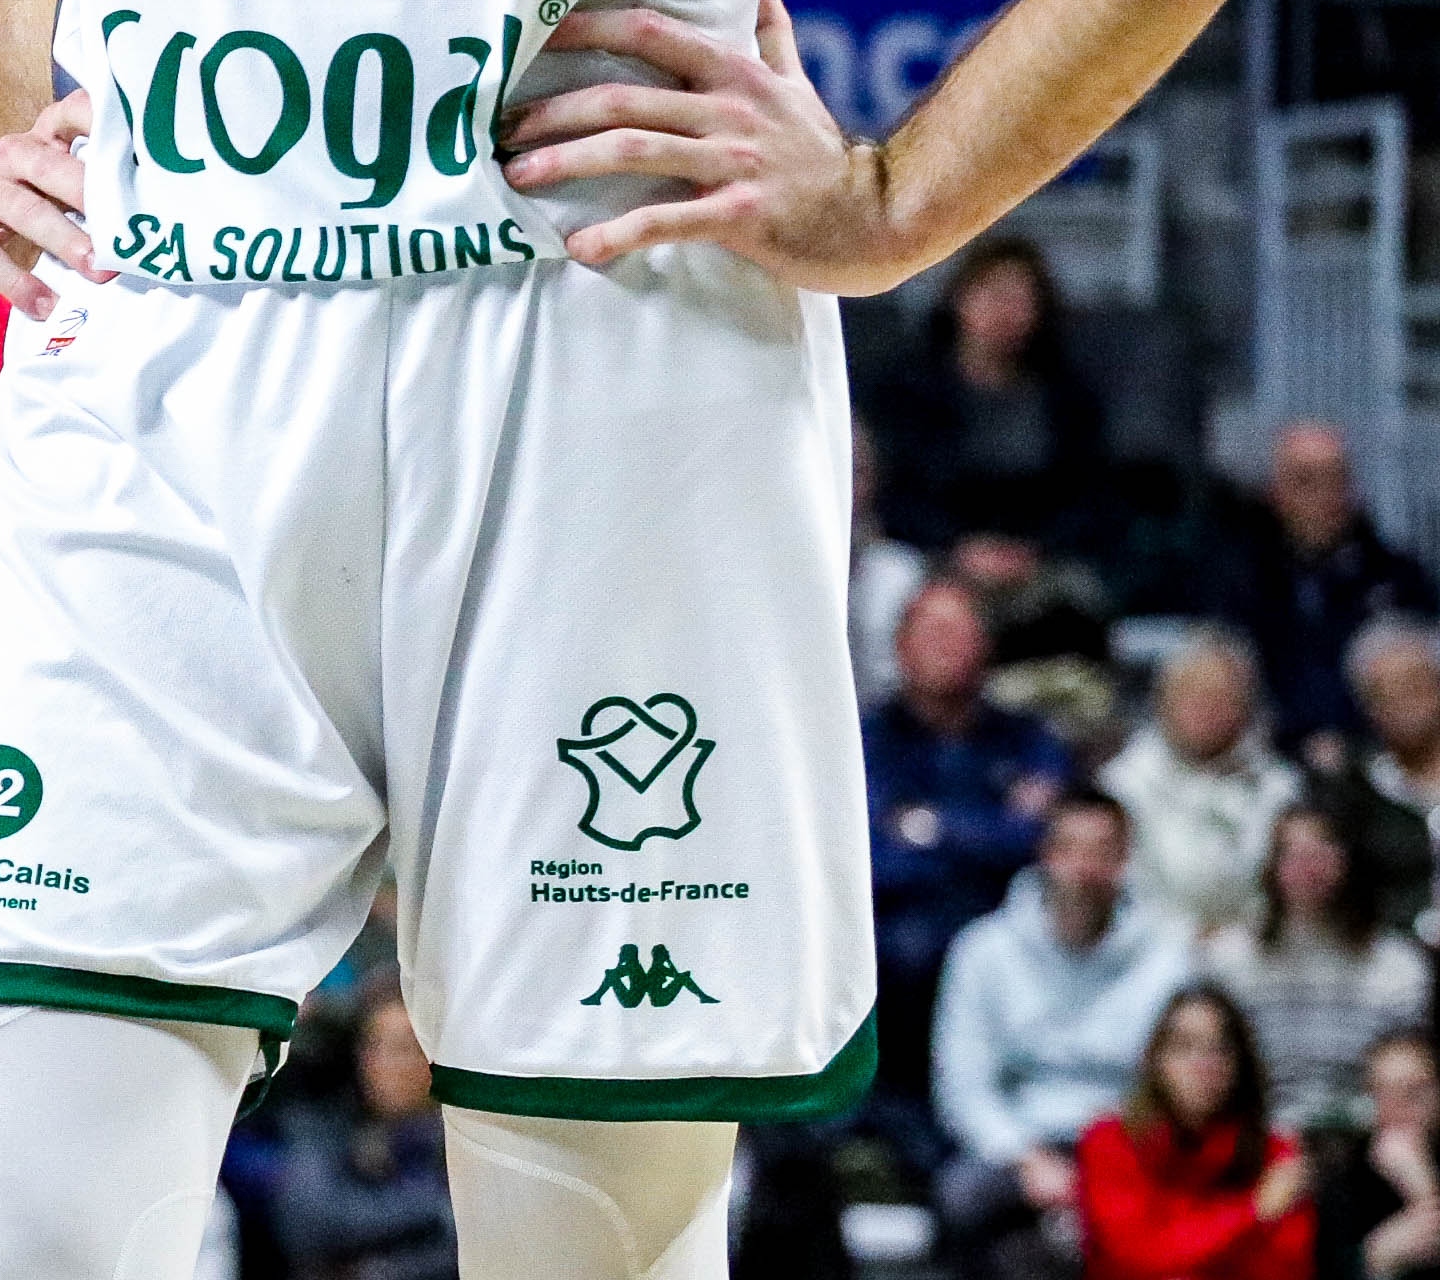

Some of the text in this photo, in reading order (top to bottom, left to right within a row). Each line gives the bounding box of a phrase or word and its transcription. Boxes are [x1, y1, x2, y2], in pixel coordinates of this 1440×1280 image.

[209, 216, 536, 284] SOLUTIONS
[530, 859, 603, 880] Région
[530, 880, 750, 904] Hauts-de-France
